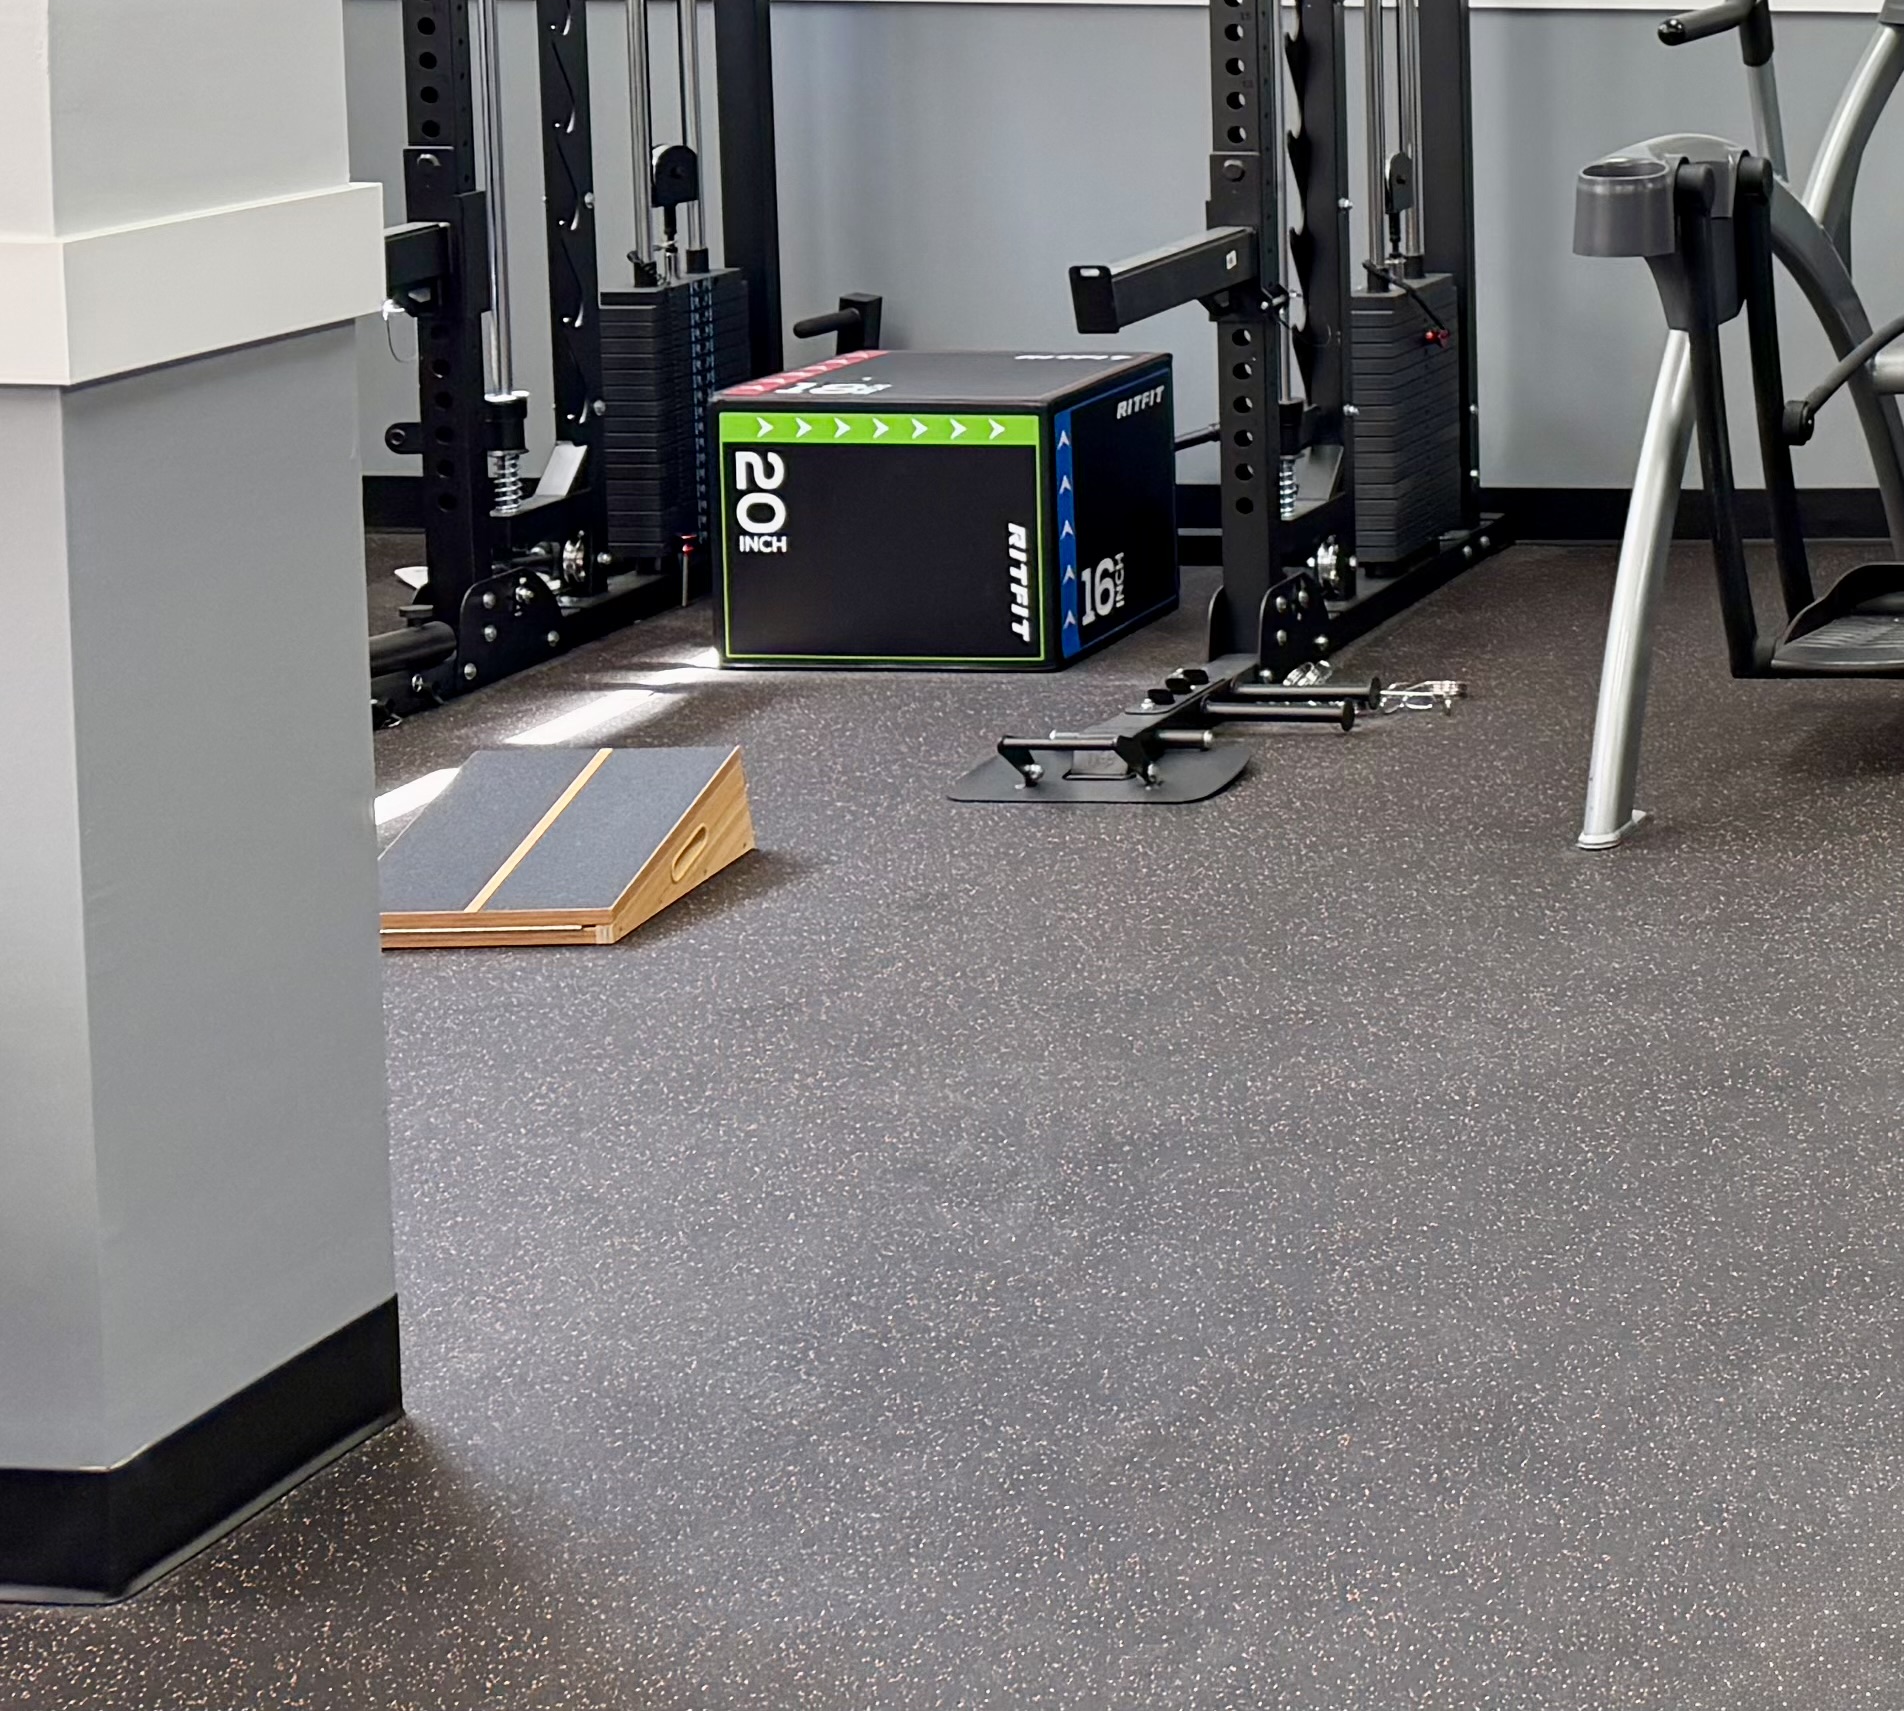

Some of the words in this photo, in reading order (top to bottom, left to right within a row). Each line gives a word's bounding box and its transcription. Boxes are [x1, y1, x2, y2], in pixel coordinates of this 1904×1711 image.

[1116, 385, 1164, 420] RITFIT
[735, 451, 786, 534] 20
[739, 535, 787, 553] INCH
[1008, 522, 1031, 642] RITFIT
[1081, 557, 1115, 626] 16
[1114, 552, 1125, 608] INCH
